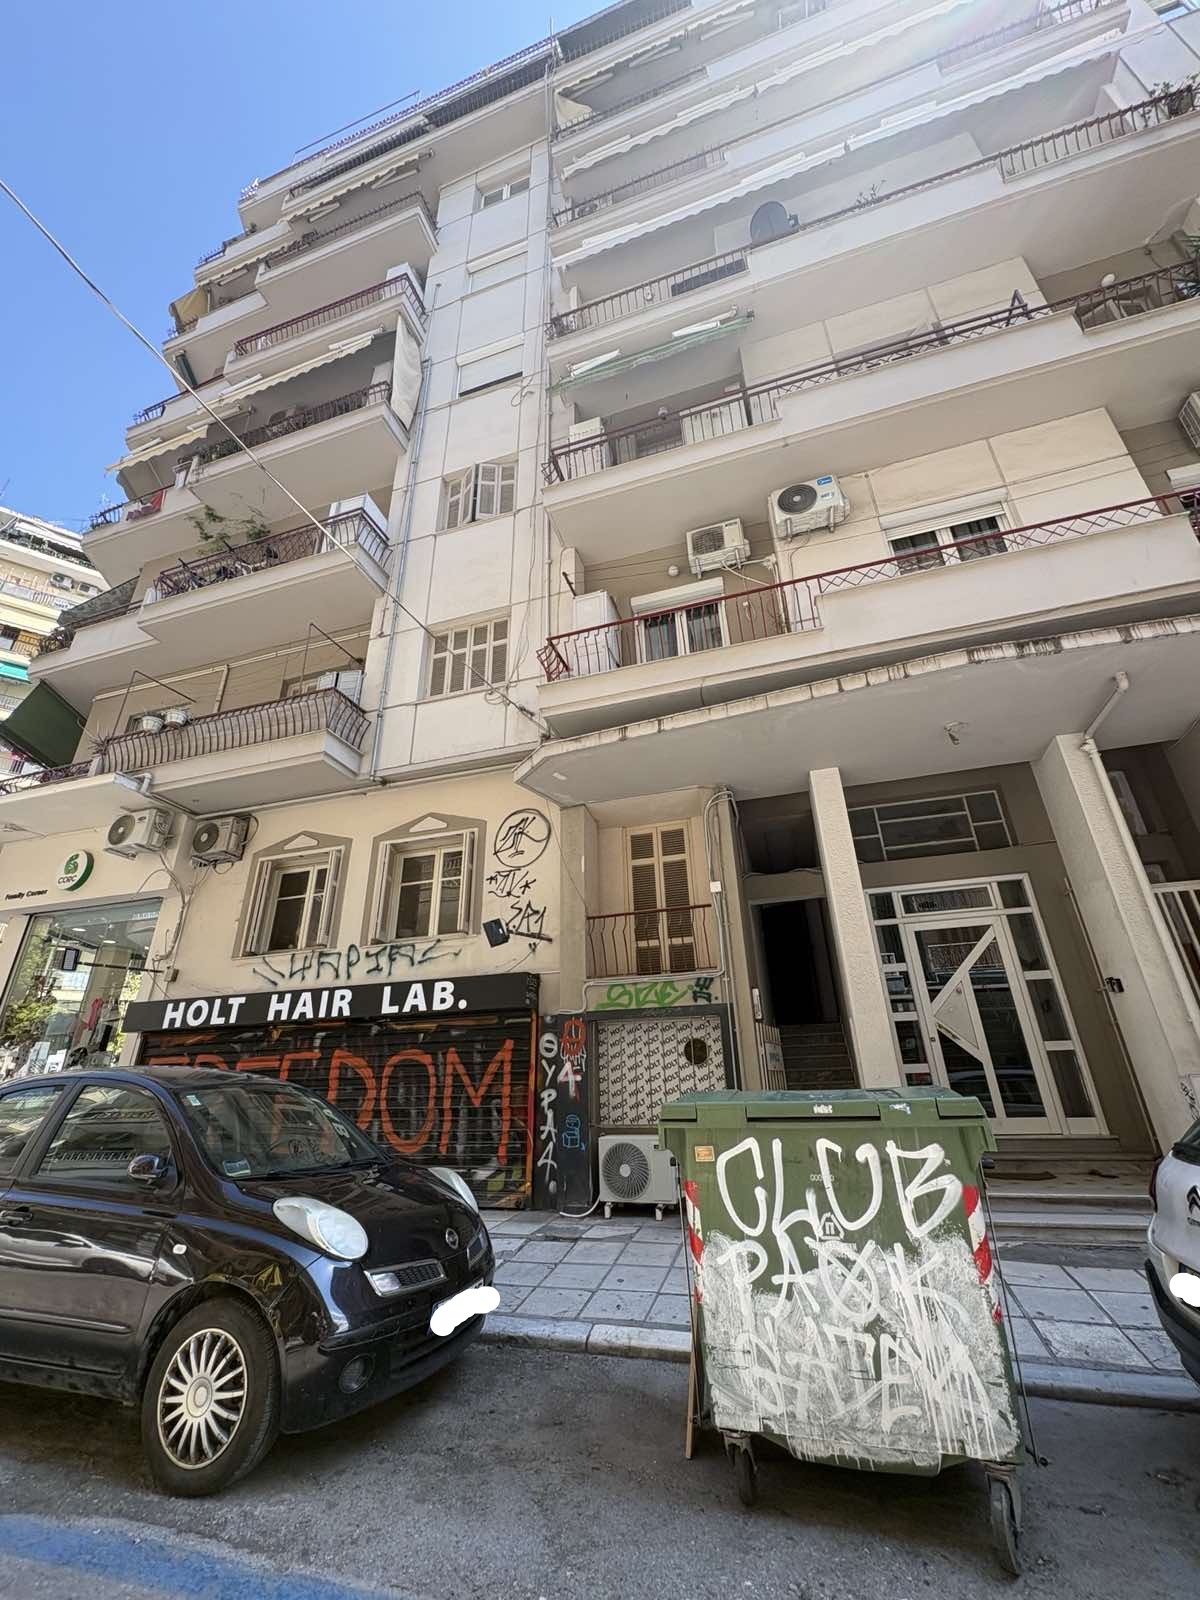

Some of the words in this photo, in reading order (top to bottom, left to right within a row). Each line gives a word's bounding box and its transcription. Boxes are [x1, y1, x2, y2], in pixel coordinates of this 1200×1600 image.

[162, 996, 247, 1030] HOLT
[266, 988, 354, 1022] HAIR
[380, 980, 469, 1015] LAB.
